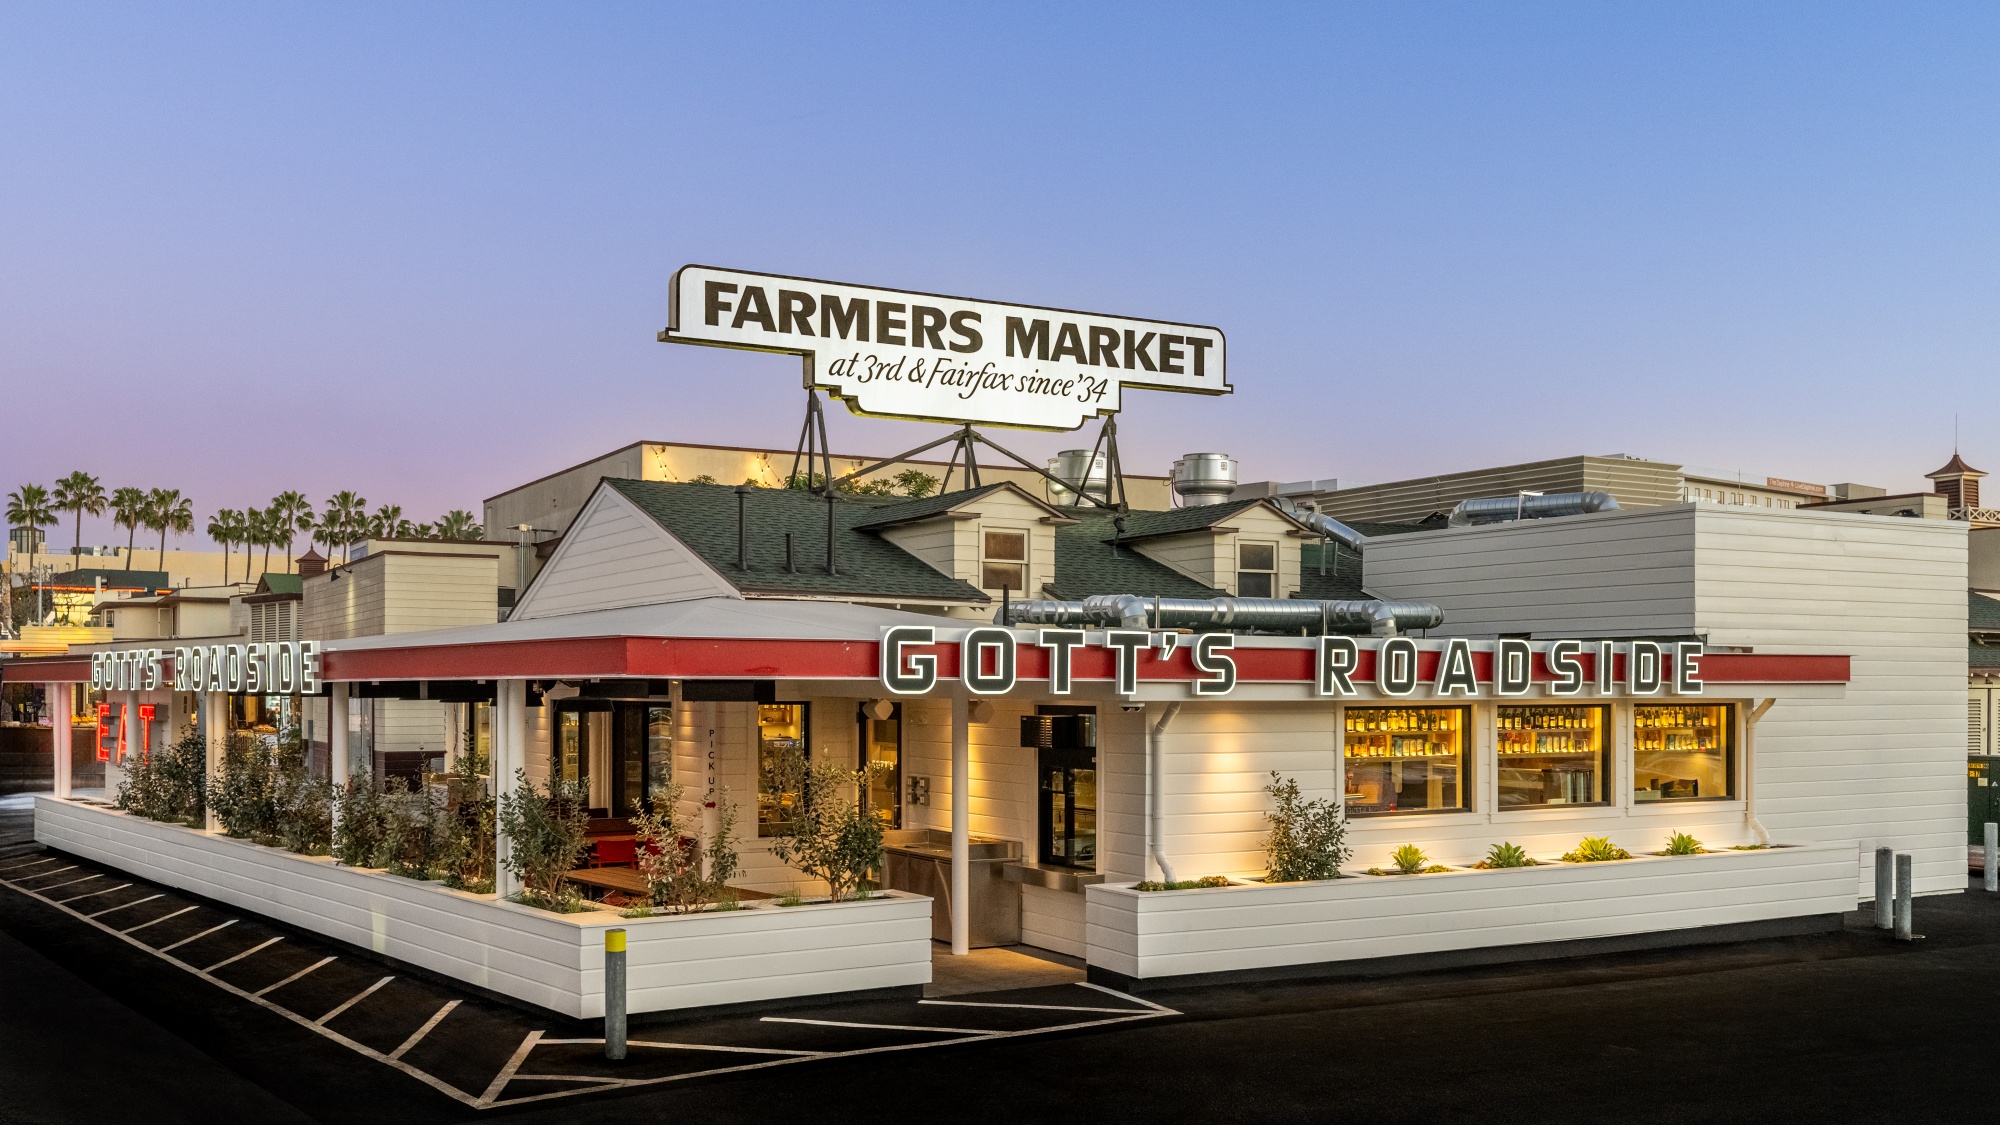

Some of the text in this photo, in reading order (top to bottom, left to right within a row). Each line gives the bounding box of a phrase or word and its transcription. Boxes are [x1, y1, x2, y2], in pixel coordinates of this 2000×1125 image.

[704, 280, 1213, 377] FARMERS MARKET
[828, 352, 859, 378] at
[858, 354, 906, 384] 3rd
[907, 357, 927, 384] &
[925, 357, 1015, 399] Fairfax
[1014, 368, 1075, 397] since
[91, 640, 318, 694] GOTT'S ROADSIDE
[882, 625, 1704, 697] GOTT'S ROADSIDE
[96, 703, 156, 764] EAT
[708, 777, 715, 794] UP
